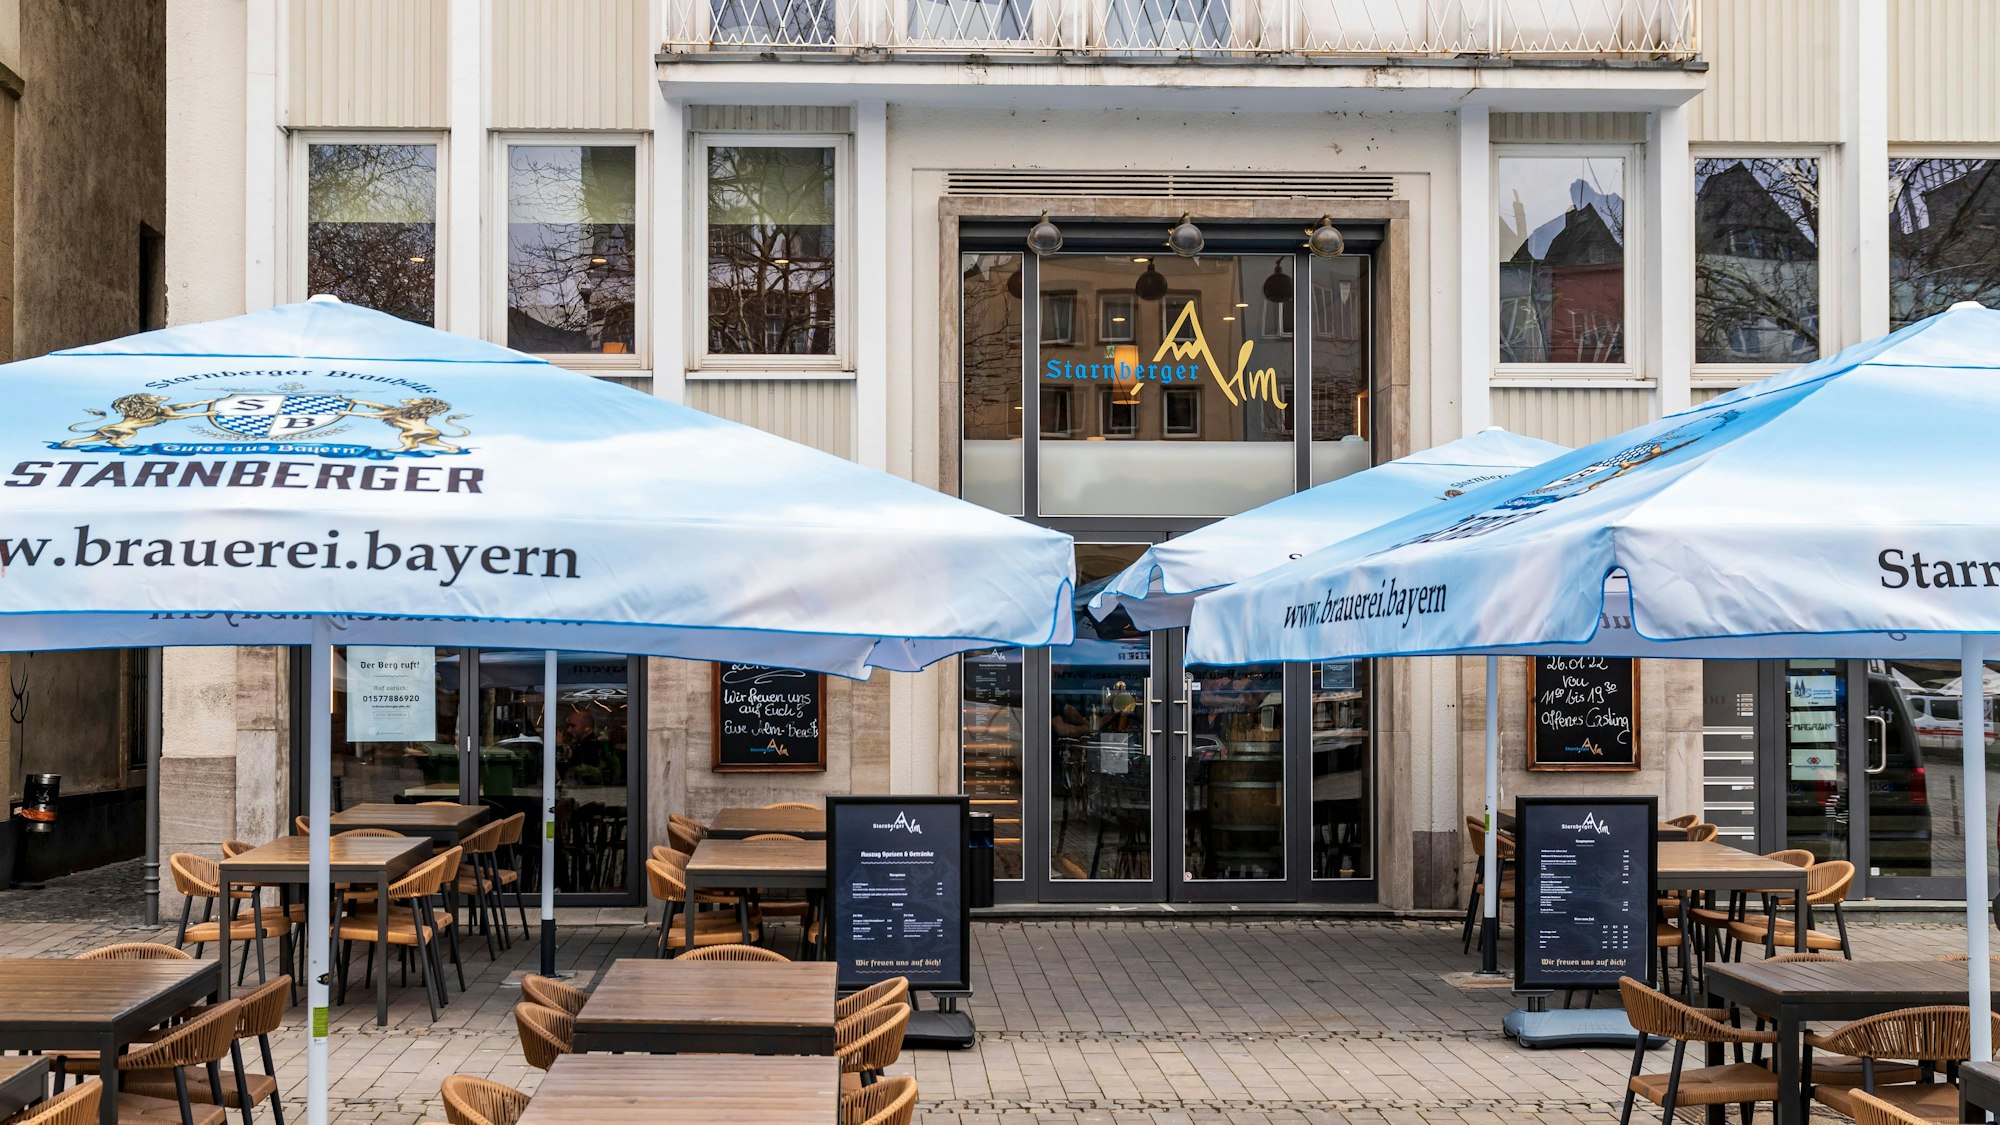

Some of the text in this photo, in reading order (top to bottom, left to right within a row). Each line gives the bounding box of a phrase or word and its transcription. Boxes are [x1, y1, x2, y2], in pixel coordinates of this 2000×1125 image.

[1046, 299, 1288, 410] Starnberger Alm
[145, 369, 437, 394] Starnberger Brauhaus
[233, 398, 268, 411] S
[280, 417, 315, 430] B
[163, 444, 356, 455] Gutes aus Bayern
[4, 461, 484, 494] STARNBERGER
[1283, 578, 1447, 630] www.brauerei.bayern
[360, 660, 420, 671] Der Berg ruft!
[362, 695, 420, 703] 01577886920
[724, 688, 811, 706] Wir freuen uns
[1565, 690, 1585, 705] bis
[739, 703, 804, 718] auf Euch!
[1541, 707, 1631, 745] Offenes Casting
[855, 959, 870, 967] Wir
[871, 959, 894, 967] freuen
[911, 958, 923, 967] auf
[925, 958, 942, 967] dich!
[1541, 958, 1555, 966] Wir
[1556, 958, 1580, 967] freuen
[1596, 958, 1608, 967] auf
[1609, 958, 1627, 967] dich!
